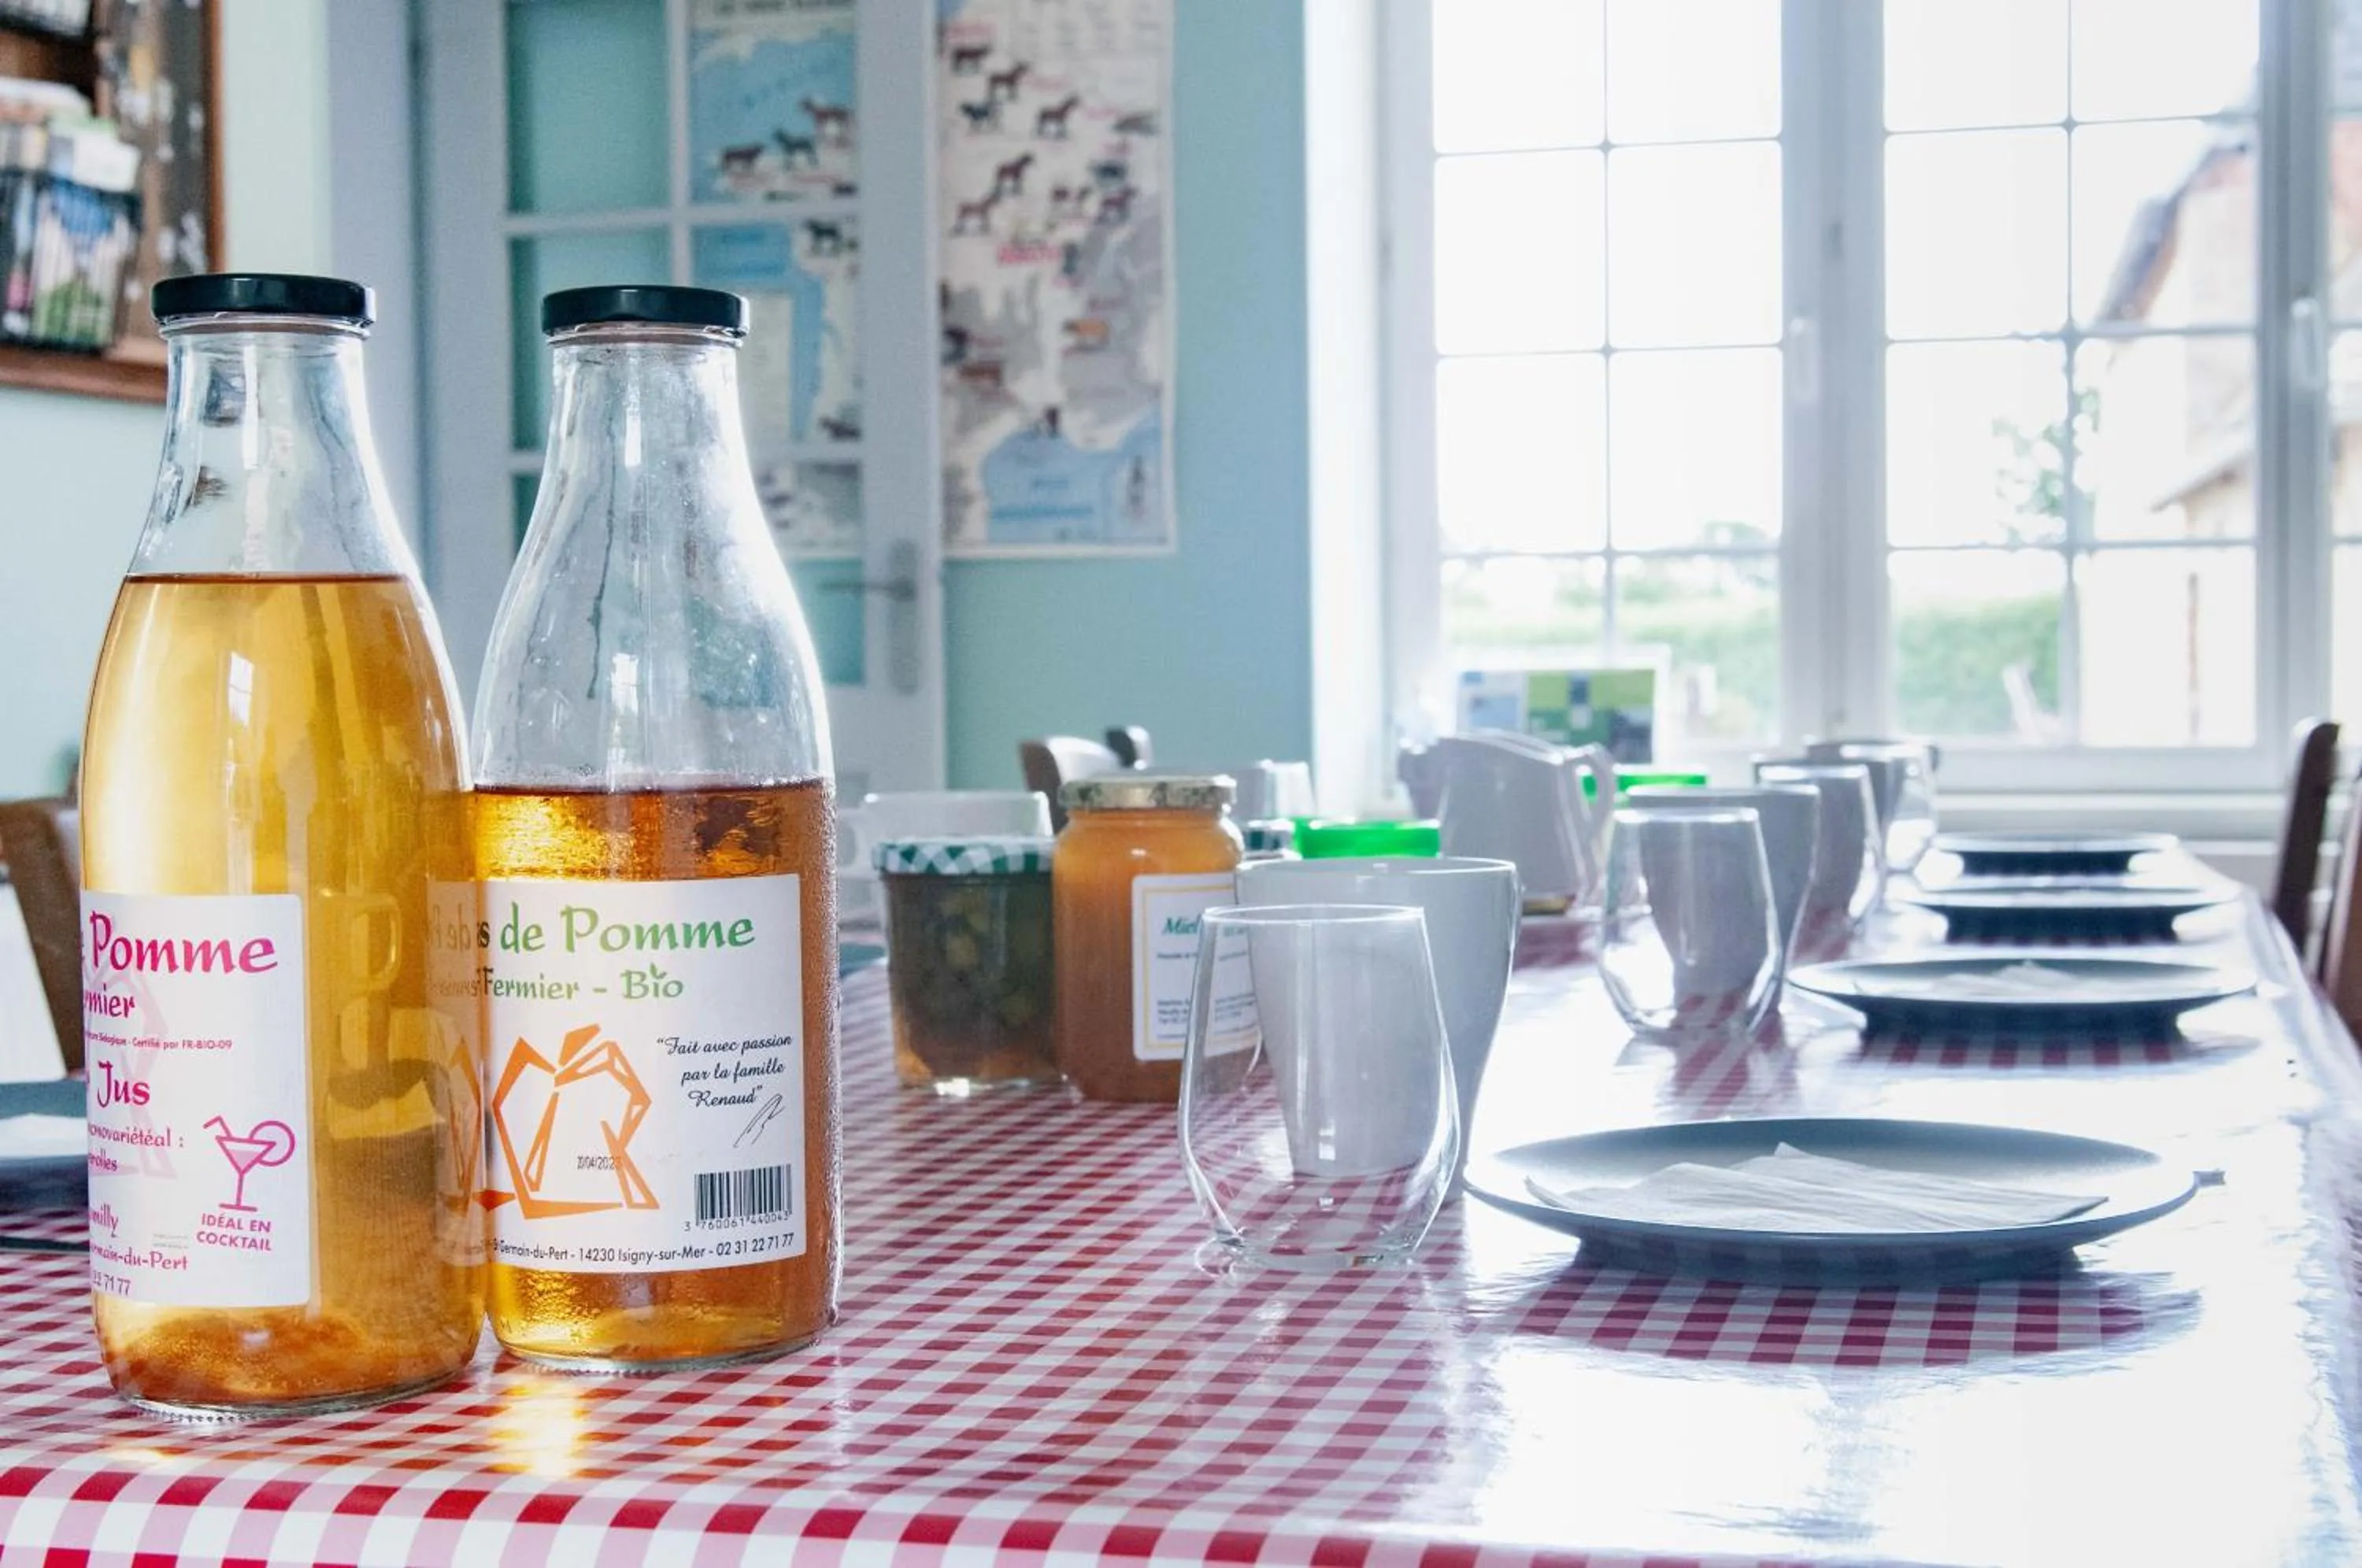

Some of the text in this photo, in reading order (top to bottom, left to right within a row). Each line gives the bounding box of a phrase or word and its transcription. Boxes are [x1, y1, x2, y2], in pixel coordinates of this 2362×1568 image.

[90, 911, 278, 974] Pomme
[500, 900, 545, 954] de
[560, 904, 756, 954] Pomme
[483, 967, 579, 1000] Fermier
[620, 963, 683, 1000] Bio
[703, 1040, 739, 1053] avec
[741, 1034, 793, 1056] passion
[97, 1060, 151, 1108] Jus
[680, 1057, 786, 1087] par la famille
[201, 1212, 272, 1233] IDÉAL EN
[196, 1230, 272, 1252] COCKTAIL
[579, 1247, 615, 1263] 14230
[618, 1245, 705, 1265] Isigny-sur-Mer
[716, 1241, 731, 1256] 02
[735, 1240, 747, 1254] 31
[752, 1237, 765, 1252] 22
[768, 1236, 779, 1251] 71
[782, 1232, 794, 1248] 77
[104, 1274, 114, 1292] 71
[117, 1277, 131, 1296] 77
